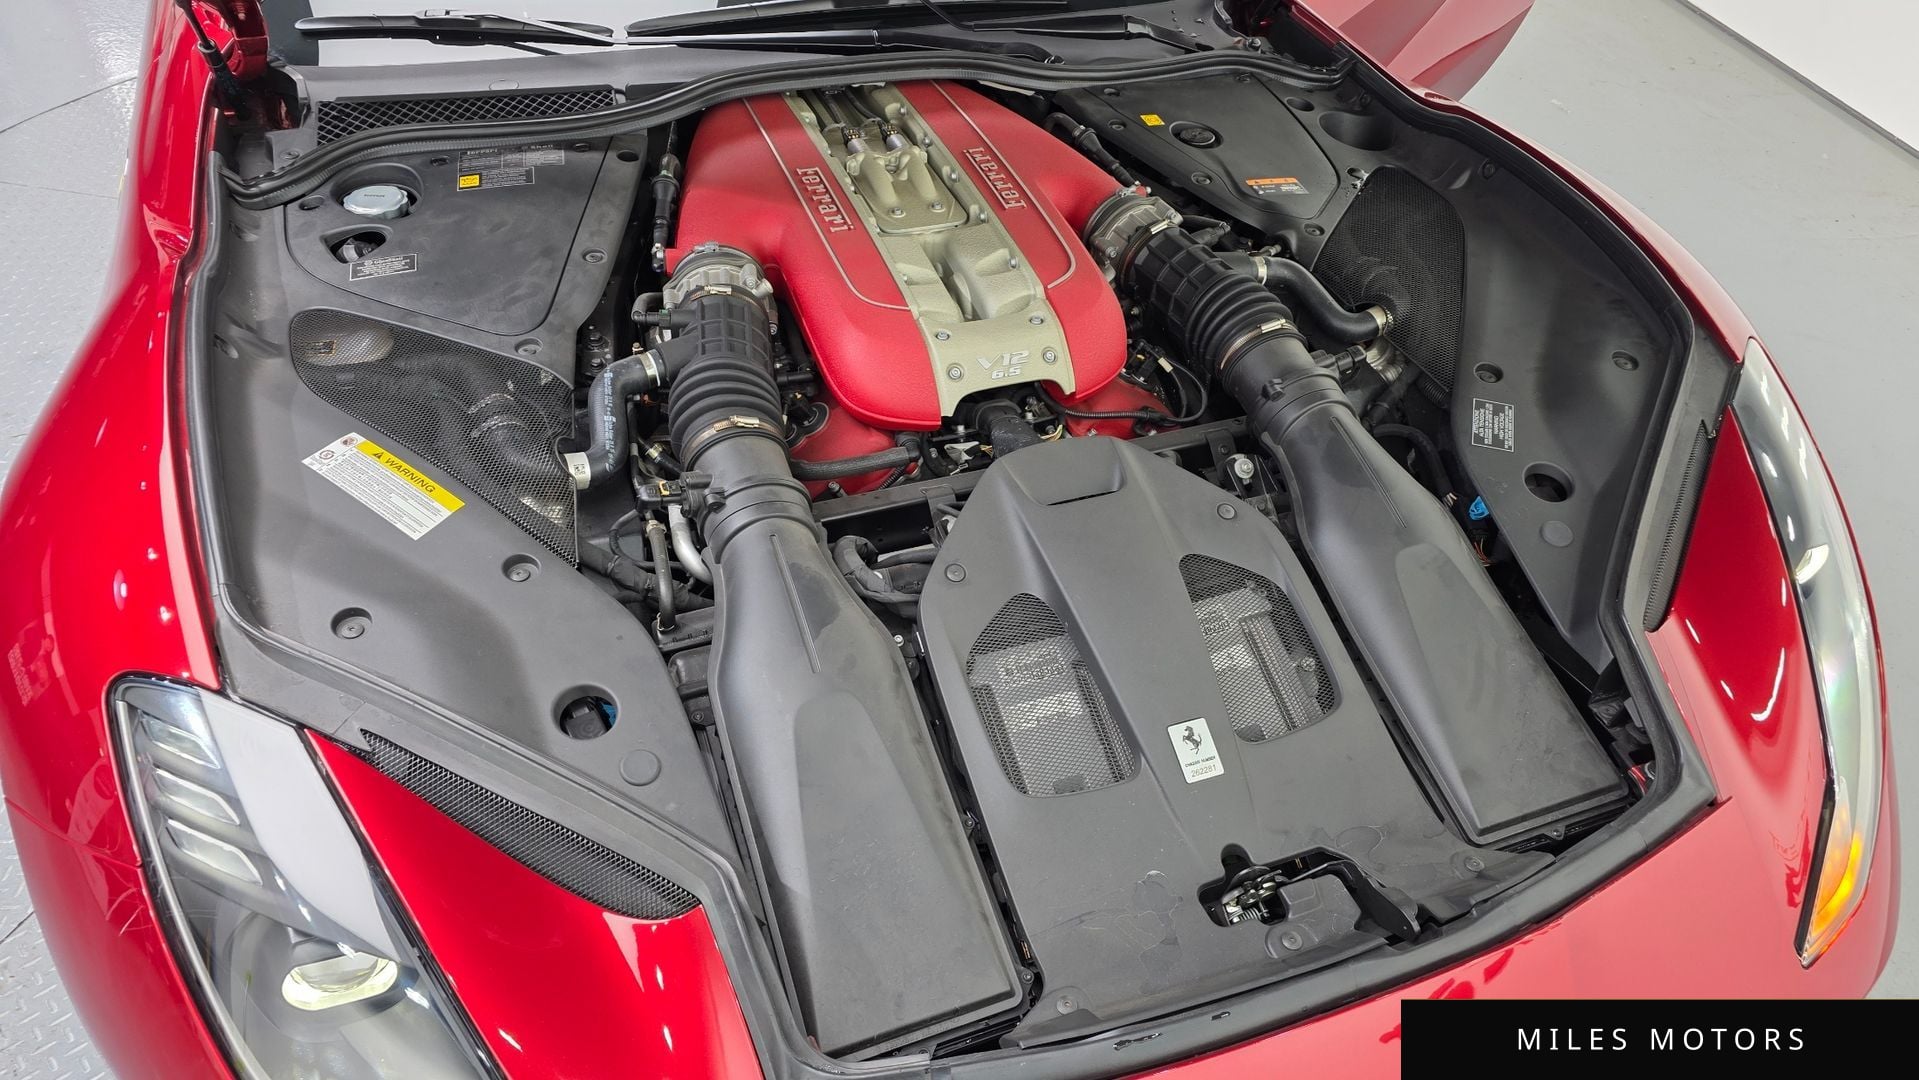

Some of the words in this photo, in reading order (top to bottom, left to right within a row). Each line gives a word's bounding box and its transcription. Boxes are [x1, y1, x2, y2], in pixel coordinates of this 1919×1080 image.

[963, 147, 1027, 209] Ferrari
[797, 167, 854, 232] Ferrari
[976, 351, 1030, 370] V12
[991, 365, 1021, 380] 6.5
[385, 457, 436, 493] WARNING
